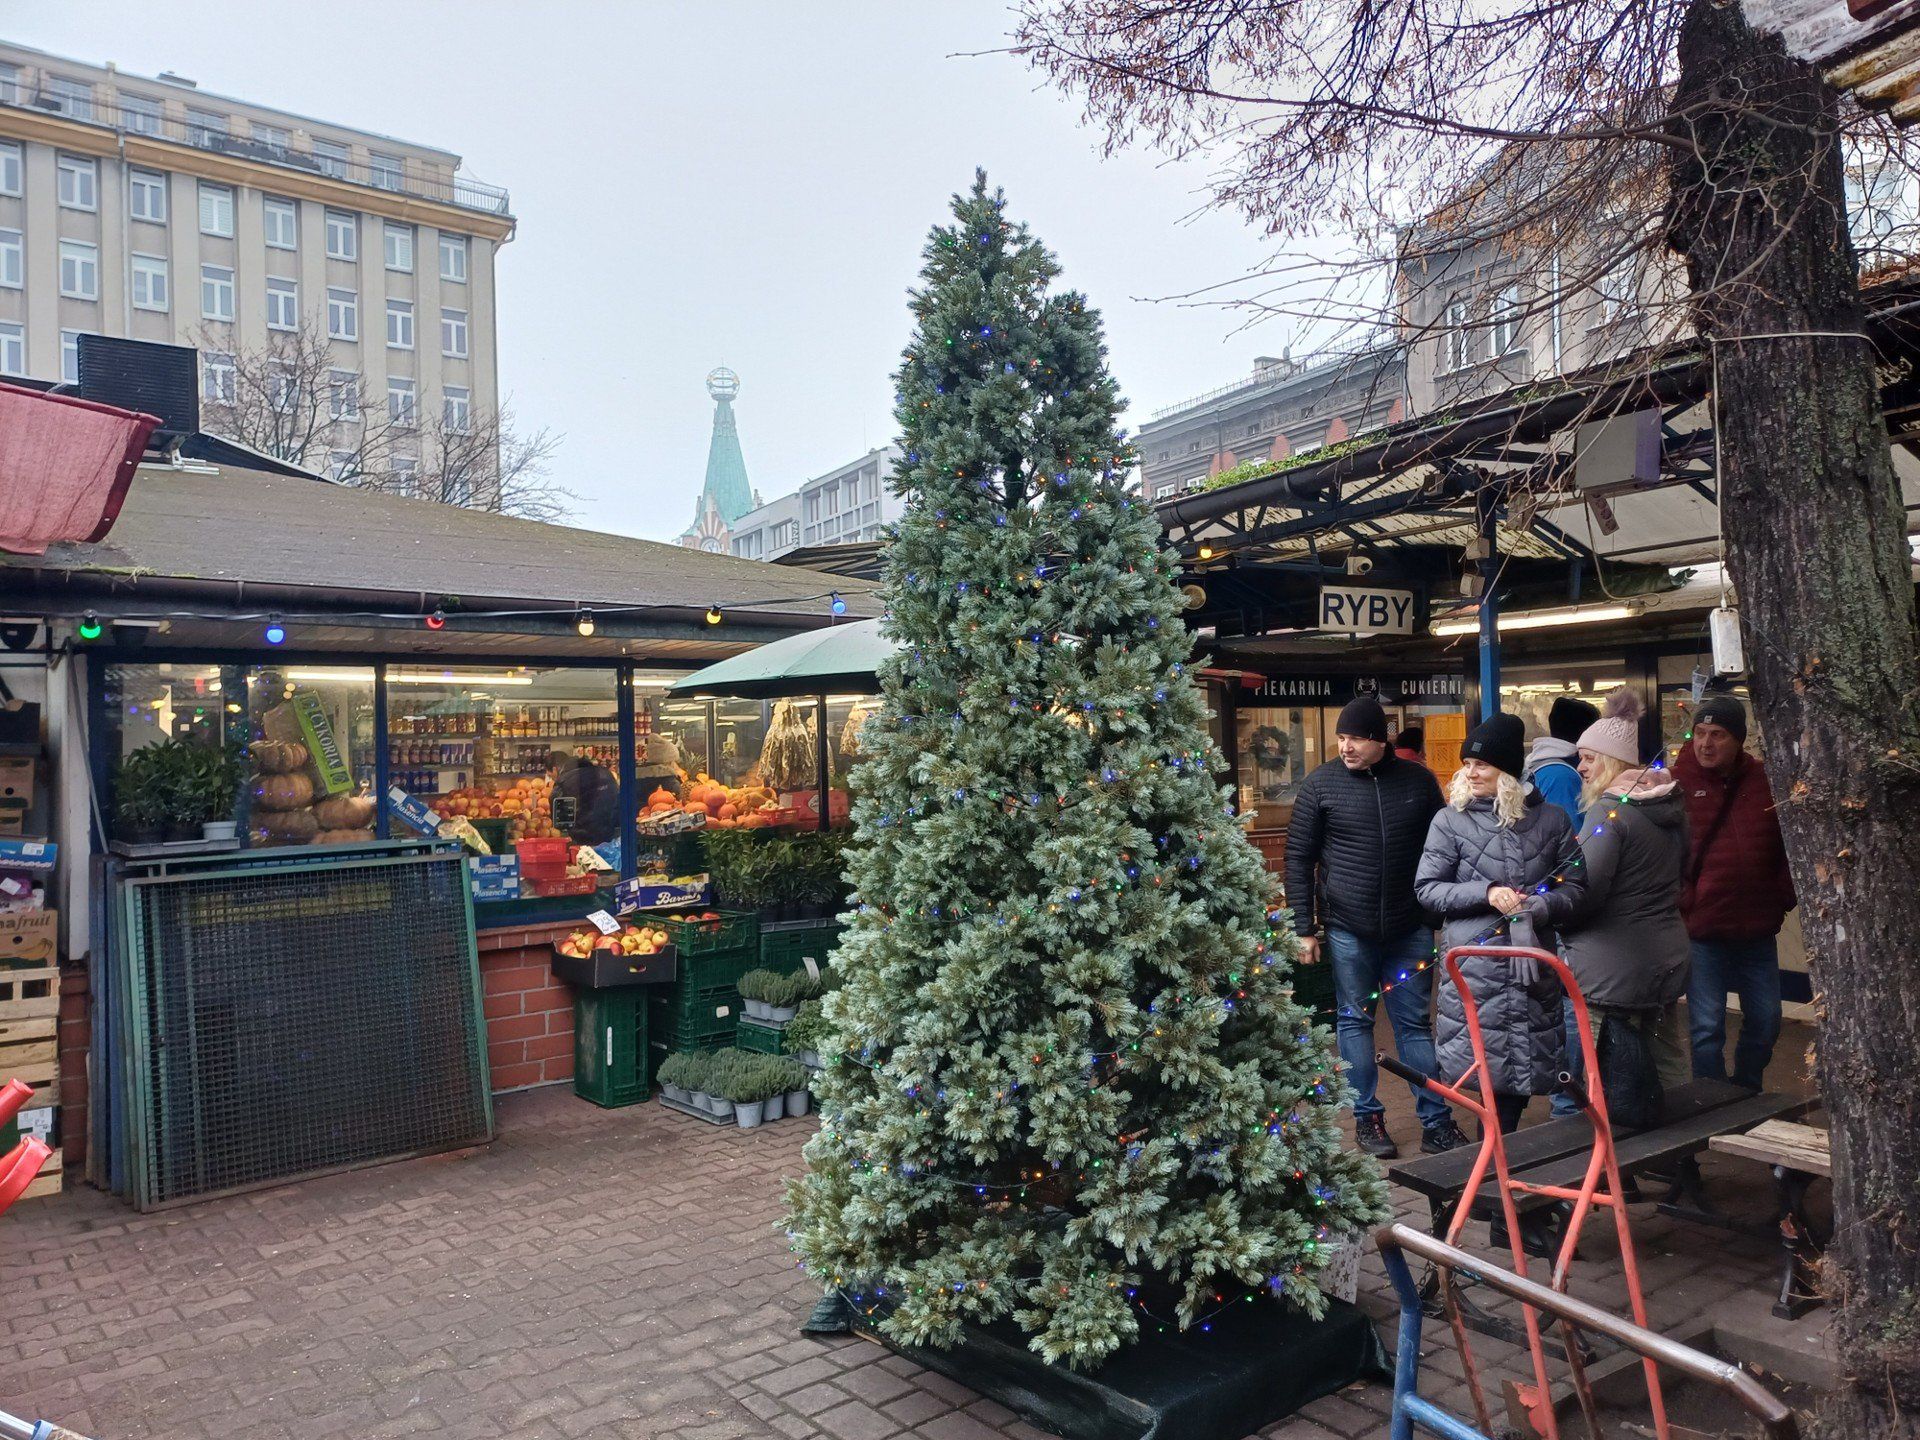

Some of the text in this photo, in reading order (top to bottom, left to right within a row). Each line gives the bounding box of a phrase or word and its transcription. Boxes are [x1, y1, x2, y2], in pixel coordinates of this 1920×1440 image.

[1322, 592, 1411, 628] RYBY
[1401, 679, 1465, 696] CUKIERNI
[310, 712, 342, 768] CYKORIA
[392, 801, 425, 825] Plasencia
[473, 865, 507, 875] Plasencia
[473, 888, 508, 898] Plasencia
